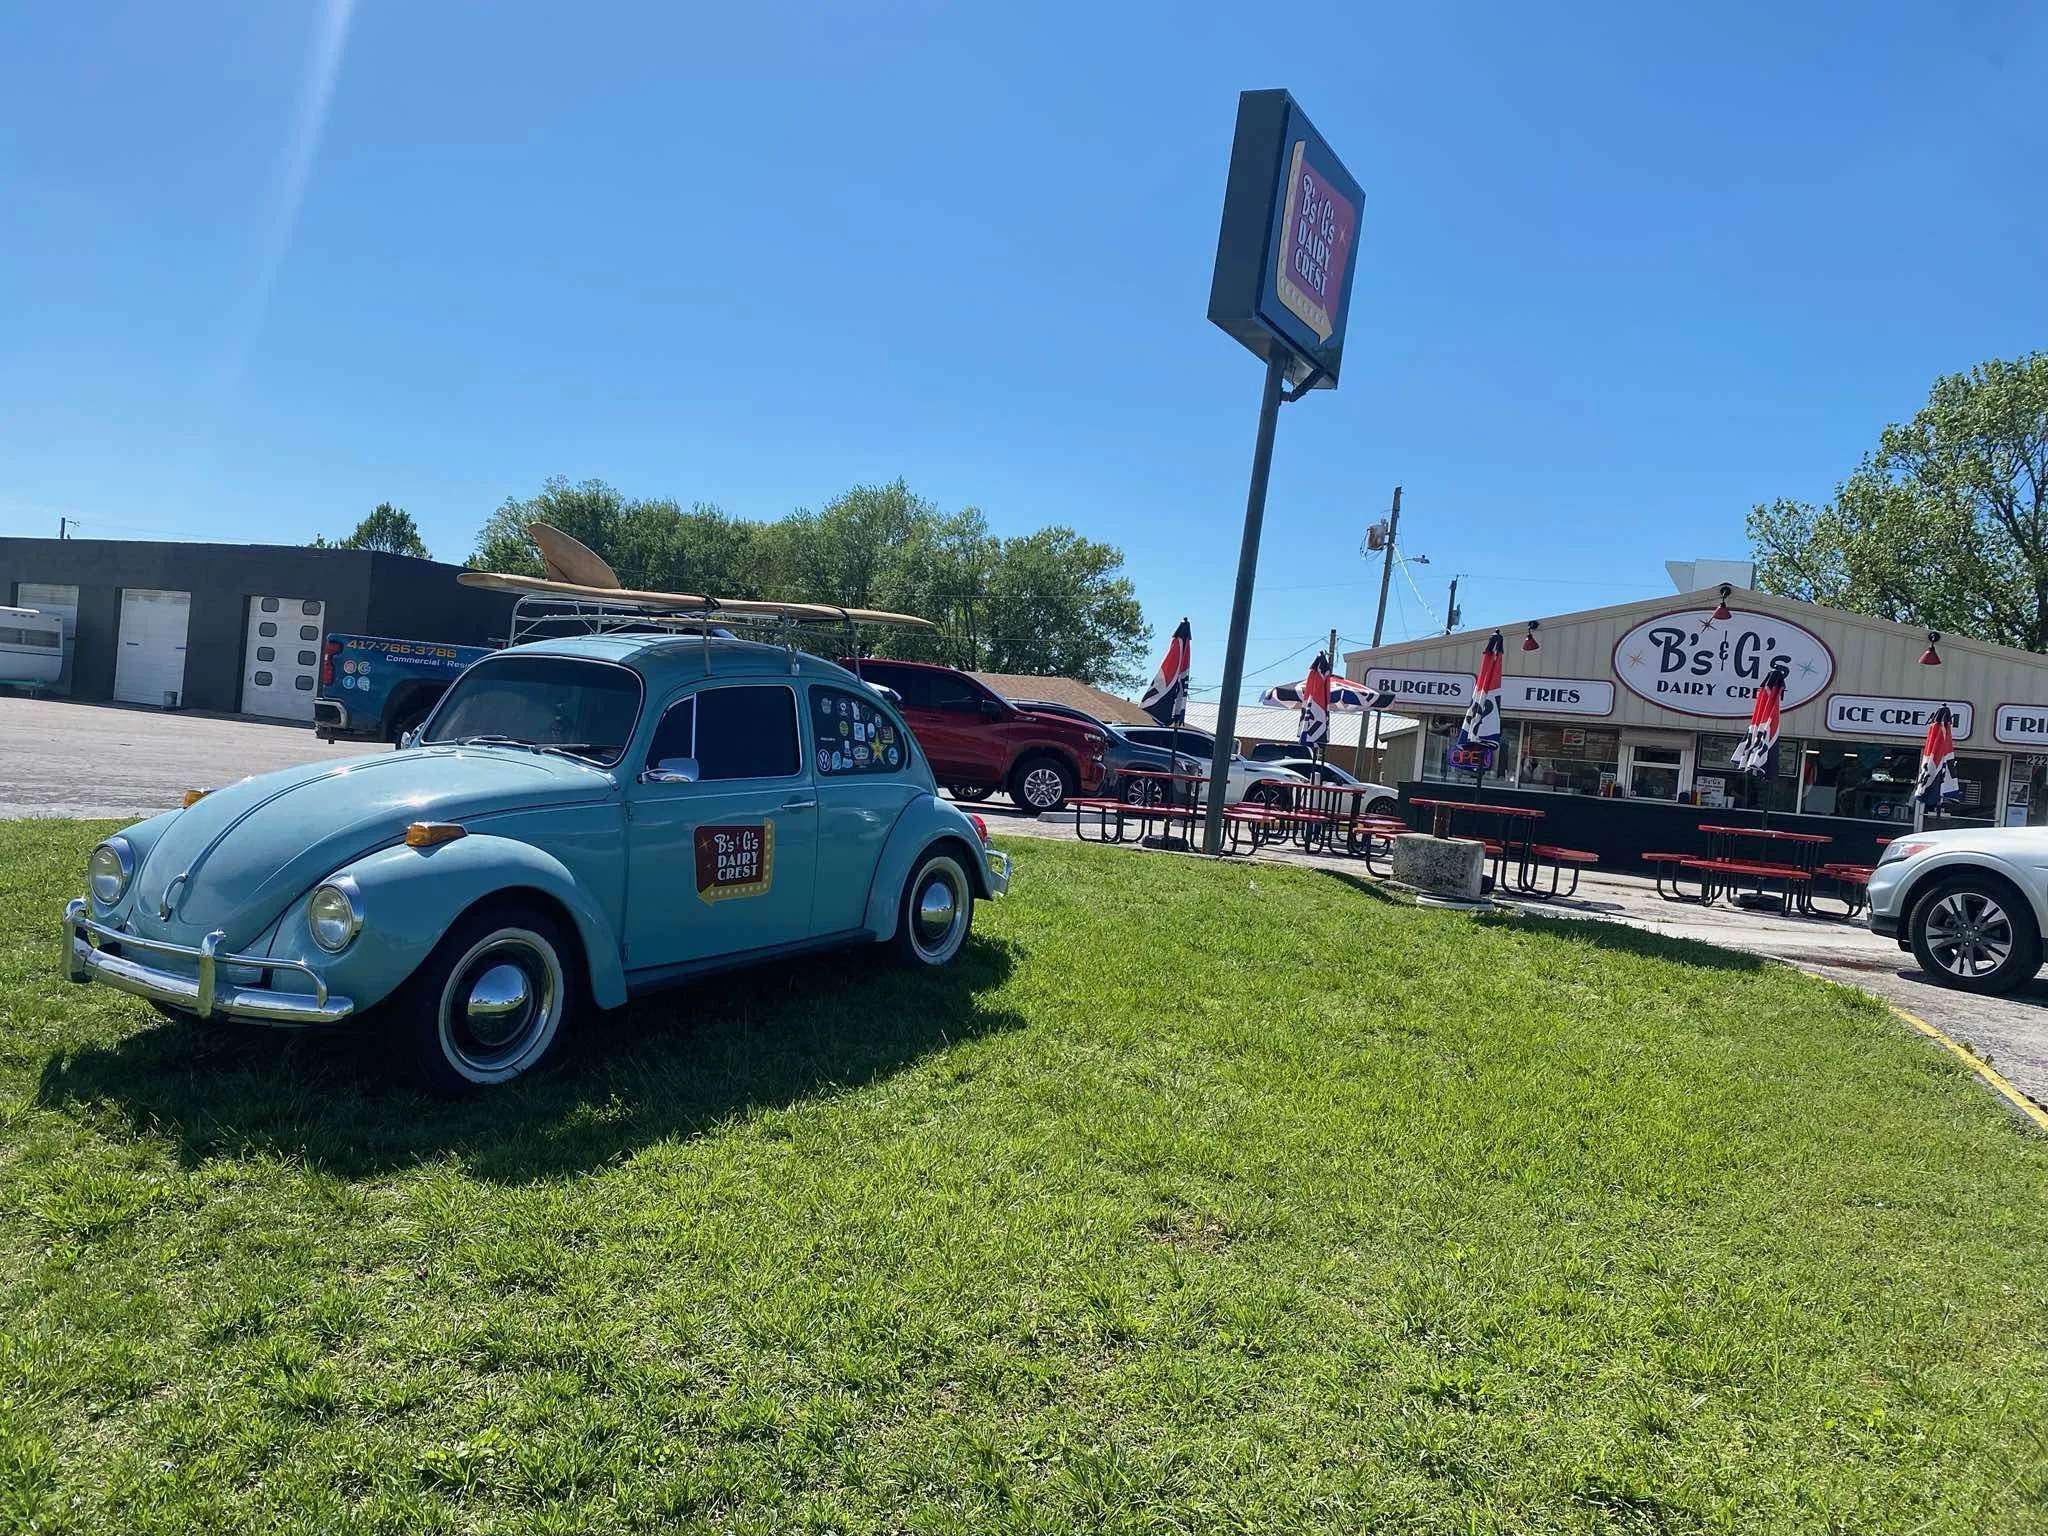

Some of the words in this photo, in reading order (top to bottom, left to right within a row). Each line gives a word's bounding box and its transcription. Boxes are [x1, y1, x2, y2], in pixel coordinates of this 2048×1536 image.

[1297, 217, 1332, 272] DAIRY
[1295, 247, 1328, 297] CREST
[386, 654, 440, 666] Commercial
[1648, 627, 1714, 676] B's
[1734, 631, 1792, 680] G's
[1378, 678, 1462, 697] BURGERS
[1525, 687, 1580, 704] FRIES
[1656, 680, 1717, 696] DAIRY
[1726, 685, 1789, 701] CRET
[1838, 706, 1874, 722] ICE
[2005, 716, 2048, 733] FRI
[714, 834, 735, 854] B's
[742, 831, 759, 850] G's
[717, 852, 759, 868] DAIRY
[717, 864, 759, 881] CREST
